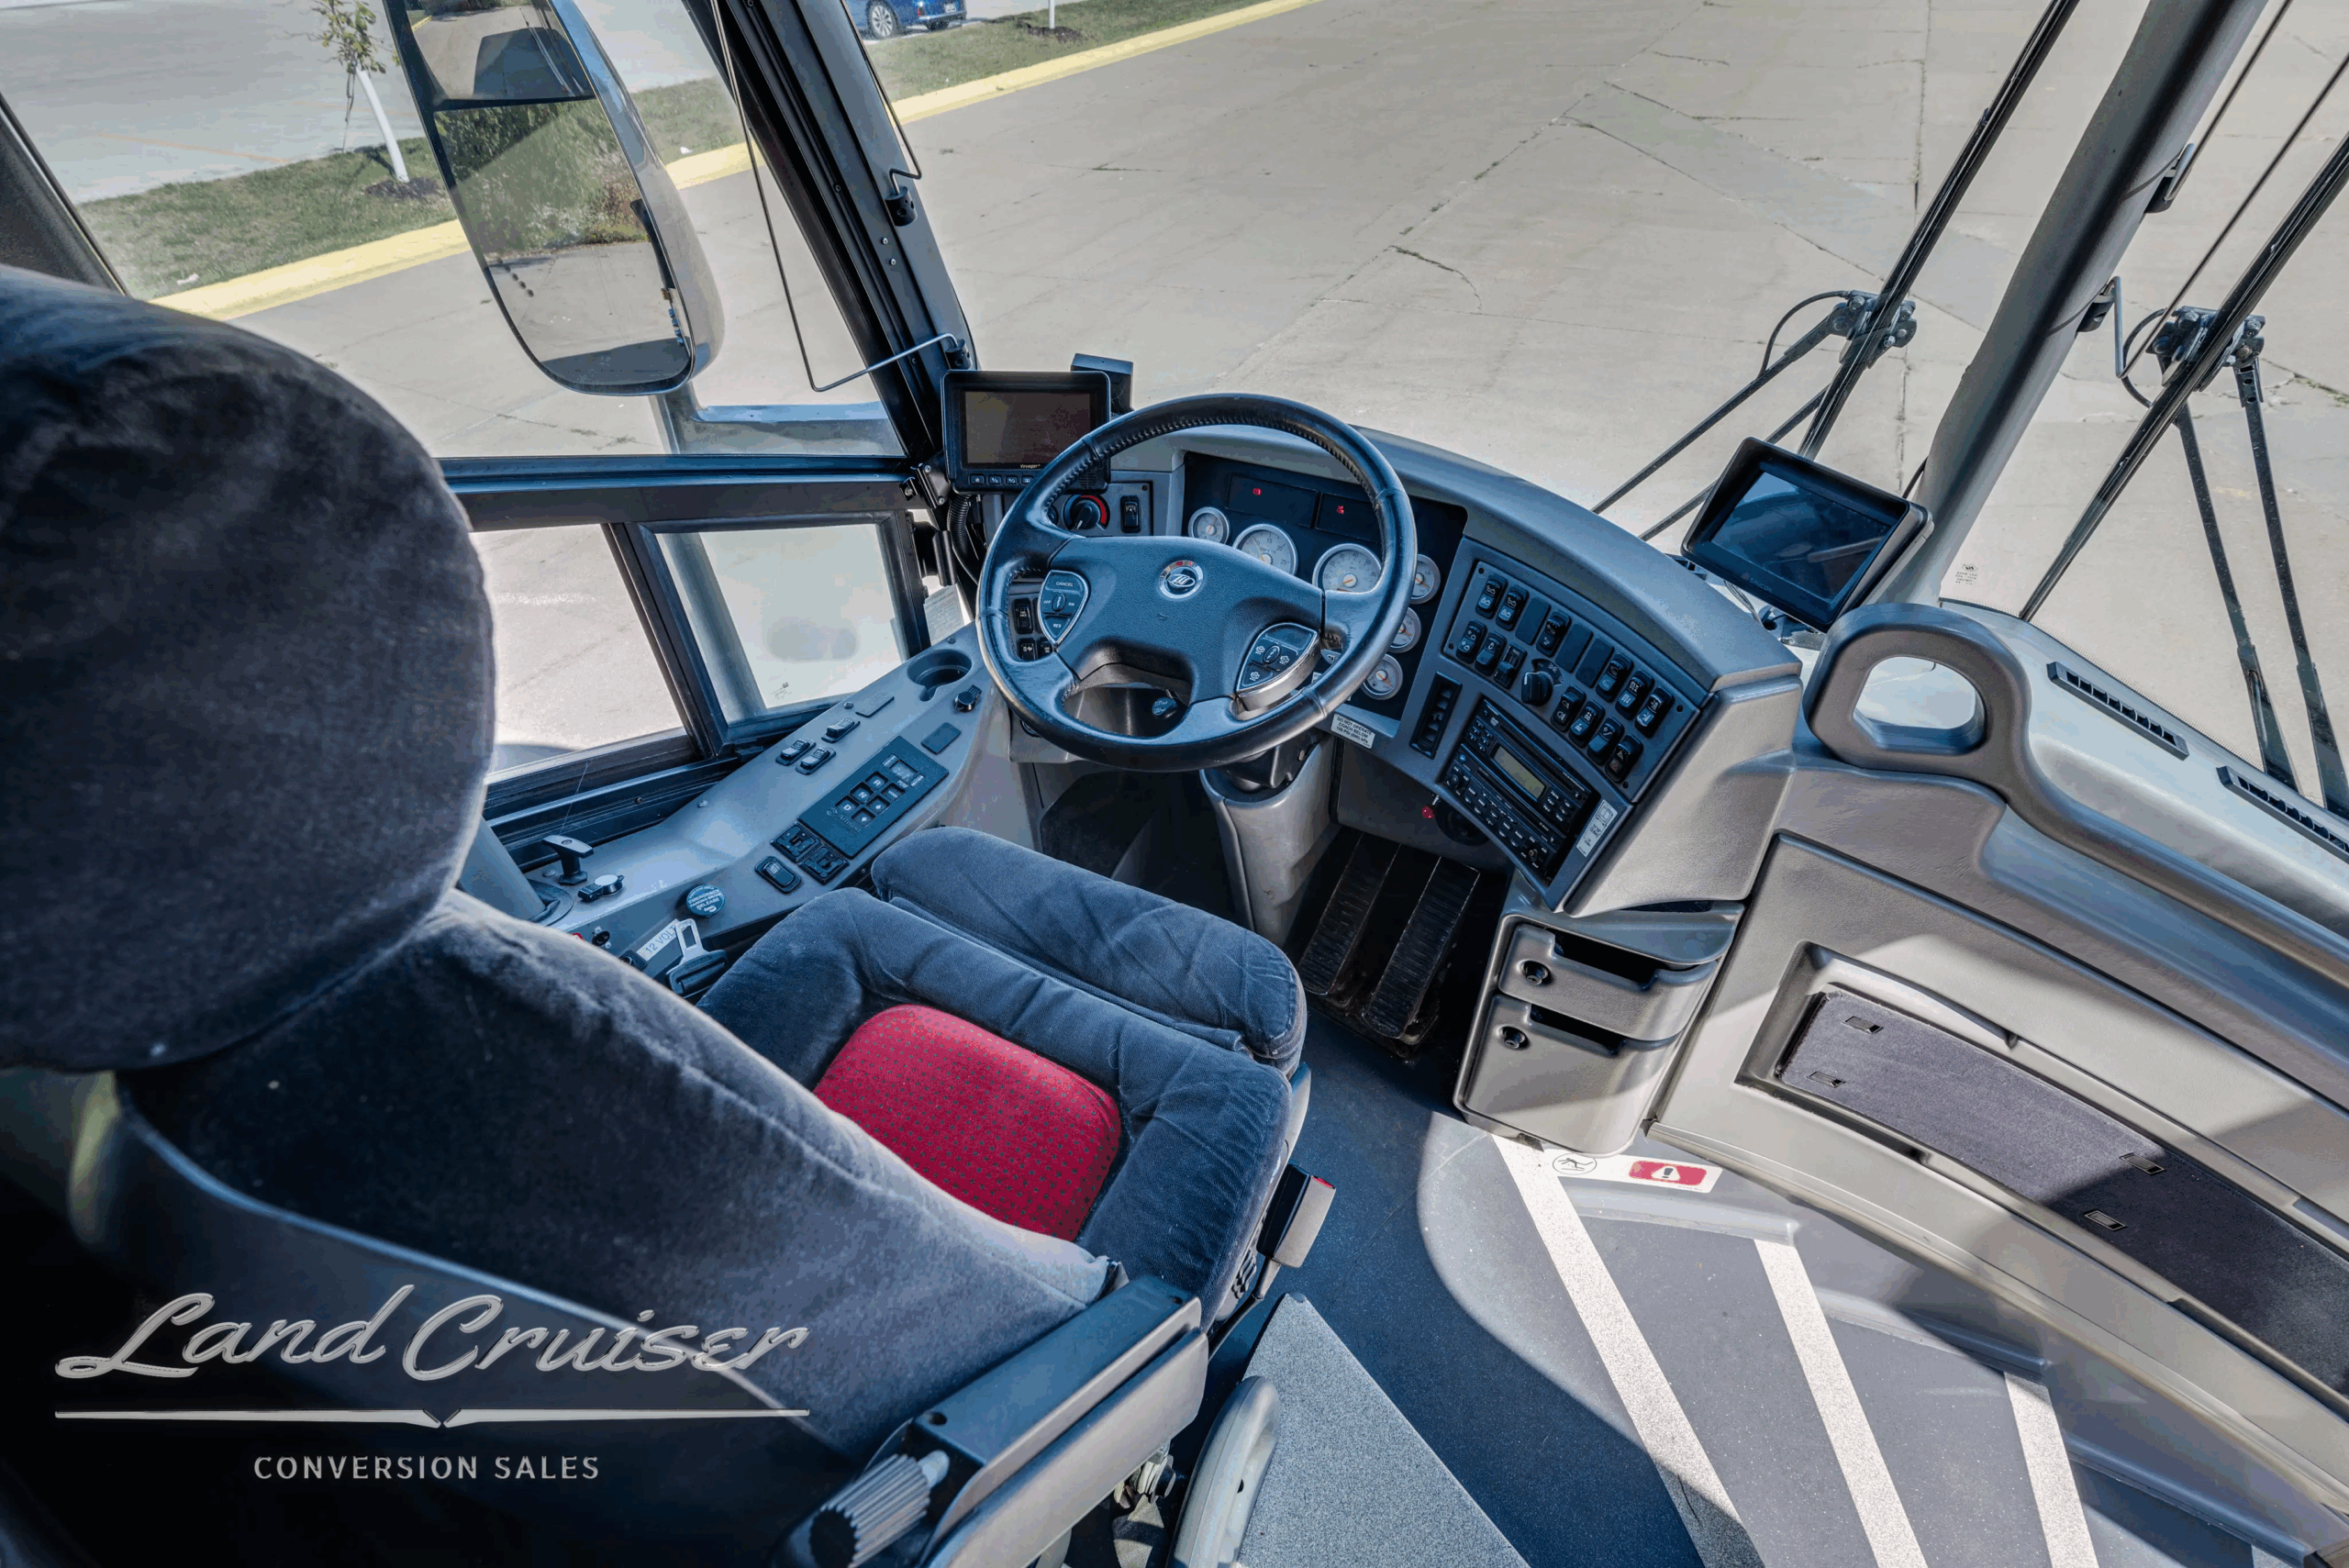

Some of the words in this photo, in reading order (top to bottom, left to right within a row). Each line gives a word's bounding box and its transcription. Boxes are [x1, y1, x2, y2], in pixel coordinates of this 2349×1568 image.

[1339, 722, 1353, 731] COACH
[1353, 728, 1369, 739] BELOW
[1353, 723, 1372, 736] OPERATE
[873, 779, 882, 787] R
[858, 791, 867, 799] N
[838, 813, 862, 834] Allison
[687, 888, 720, 905] EMERGENCY
[696, 896, 720, 910] RELEASE
[645, 941, 659, 955] 12
[655, 924, 677, 944] VOLT
